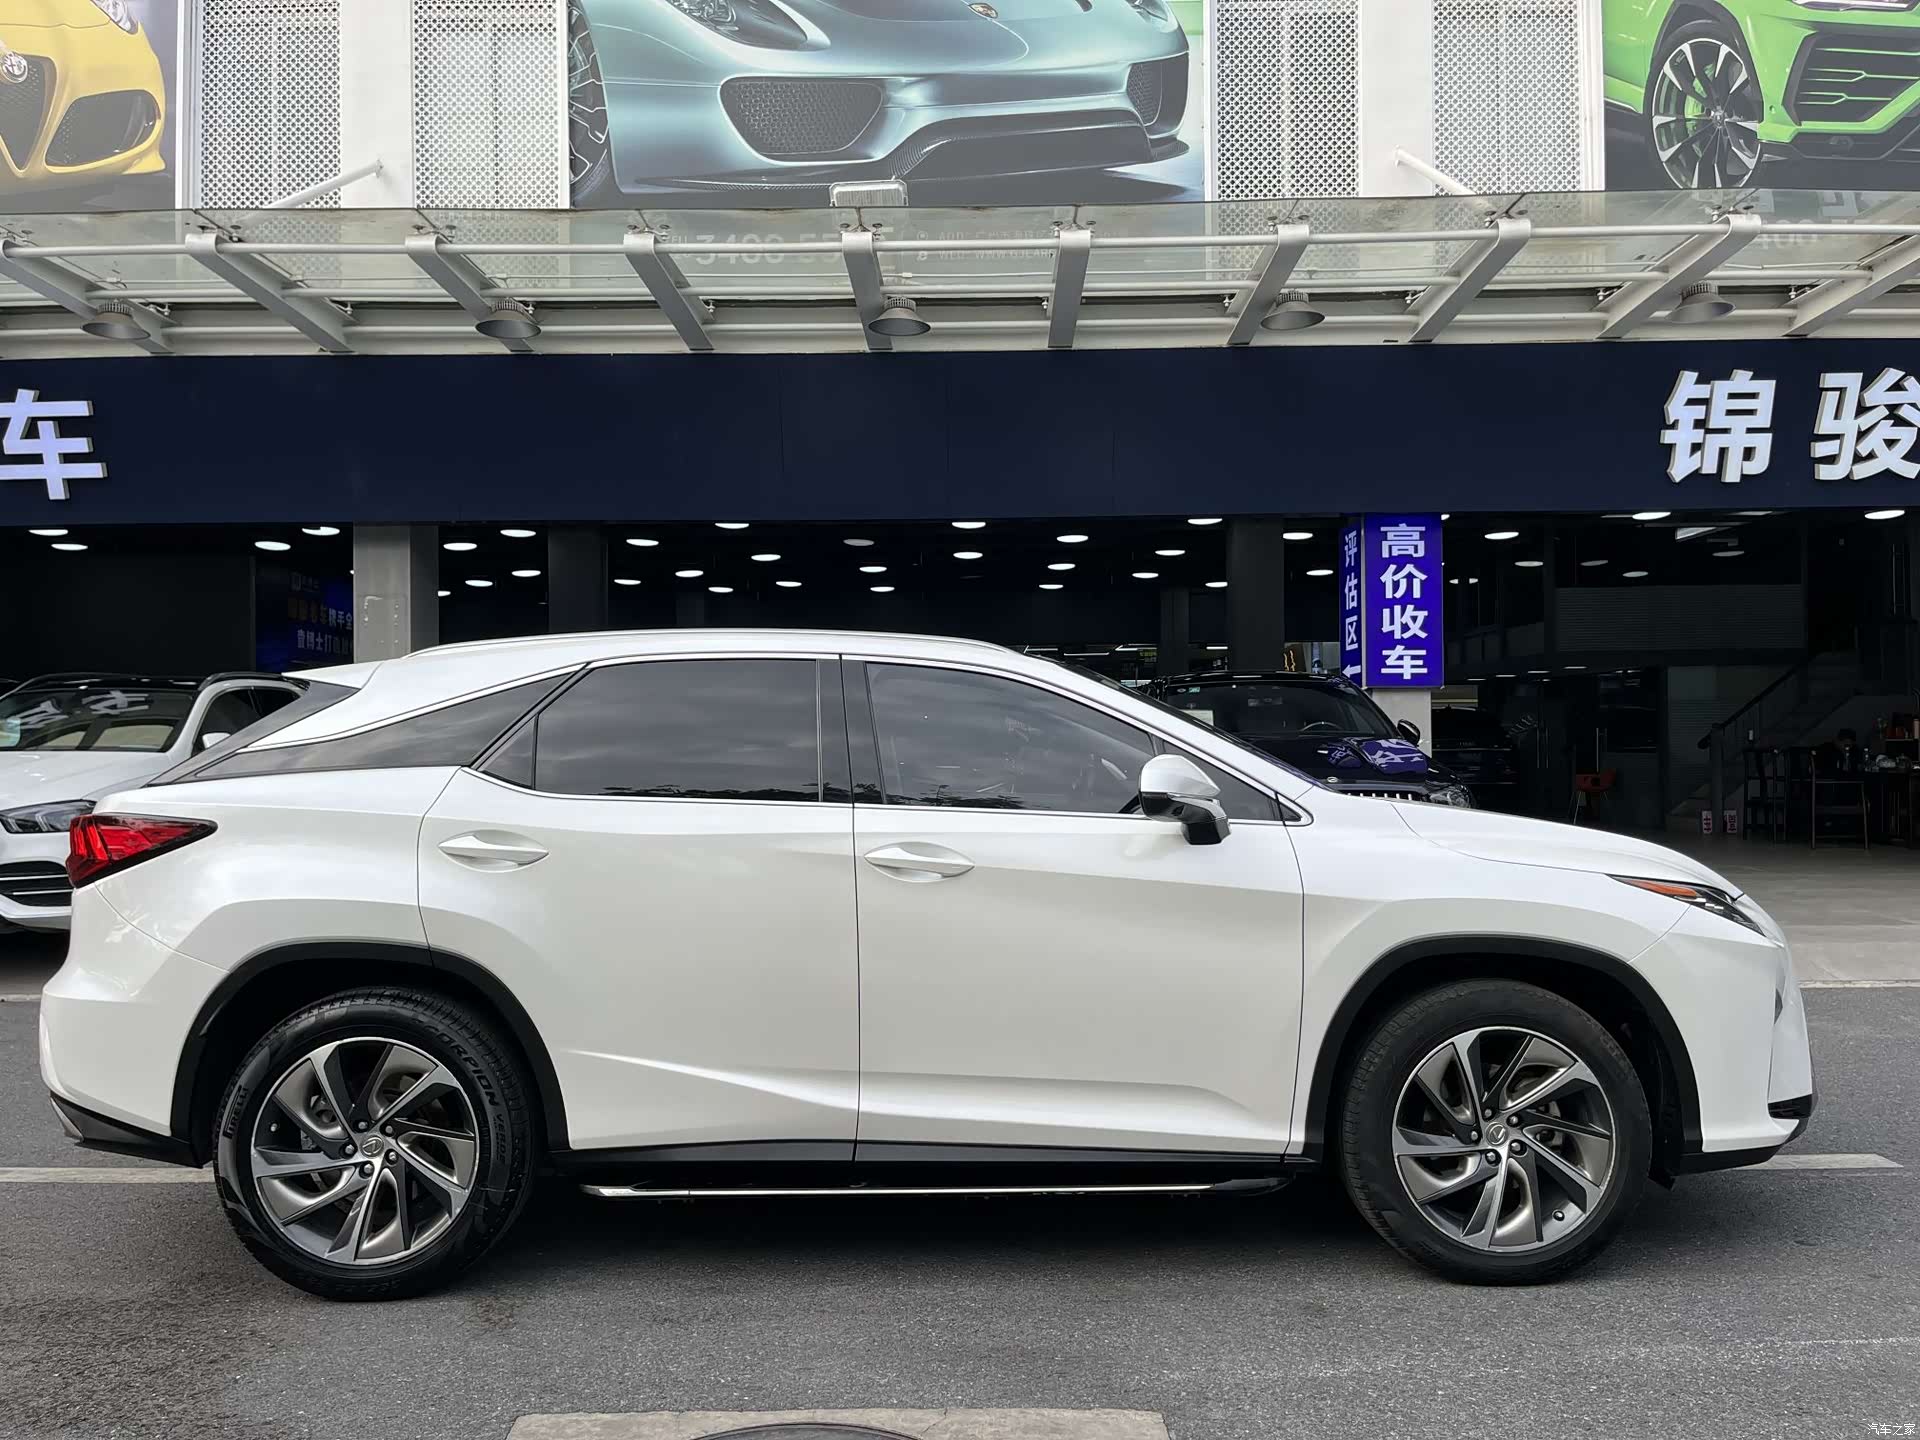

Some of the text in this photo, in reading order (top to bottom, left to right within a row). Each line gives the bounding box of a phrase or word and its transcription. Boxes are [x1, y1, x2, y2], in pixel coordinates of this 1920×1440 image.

[0, 388, 108, 500] 车
[1660, 368, 1920, 483] 锦骏
[1344, 529, 1359, 651] 评估区
[1379, 523, 1428, 679] 高价收车
[223, 1084, 249, 1139] PIRELLI
